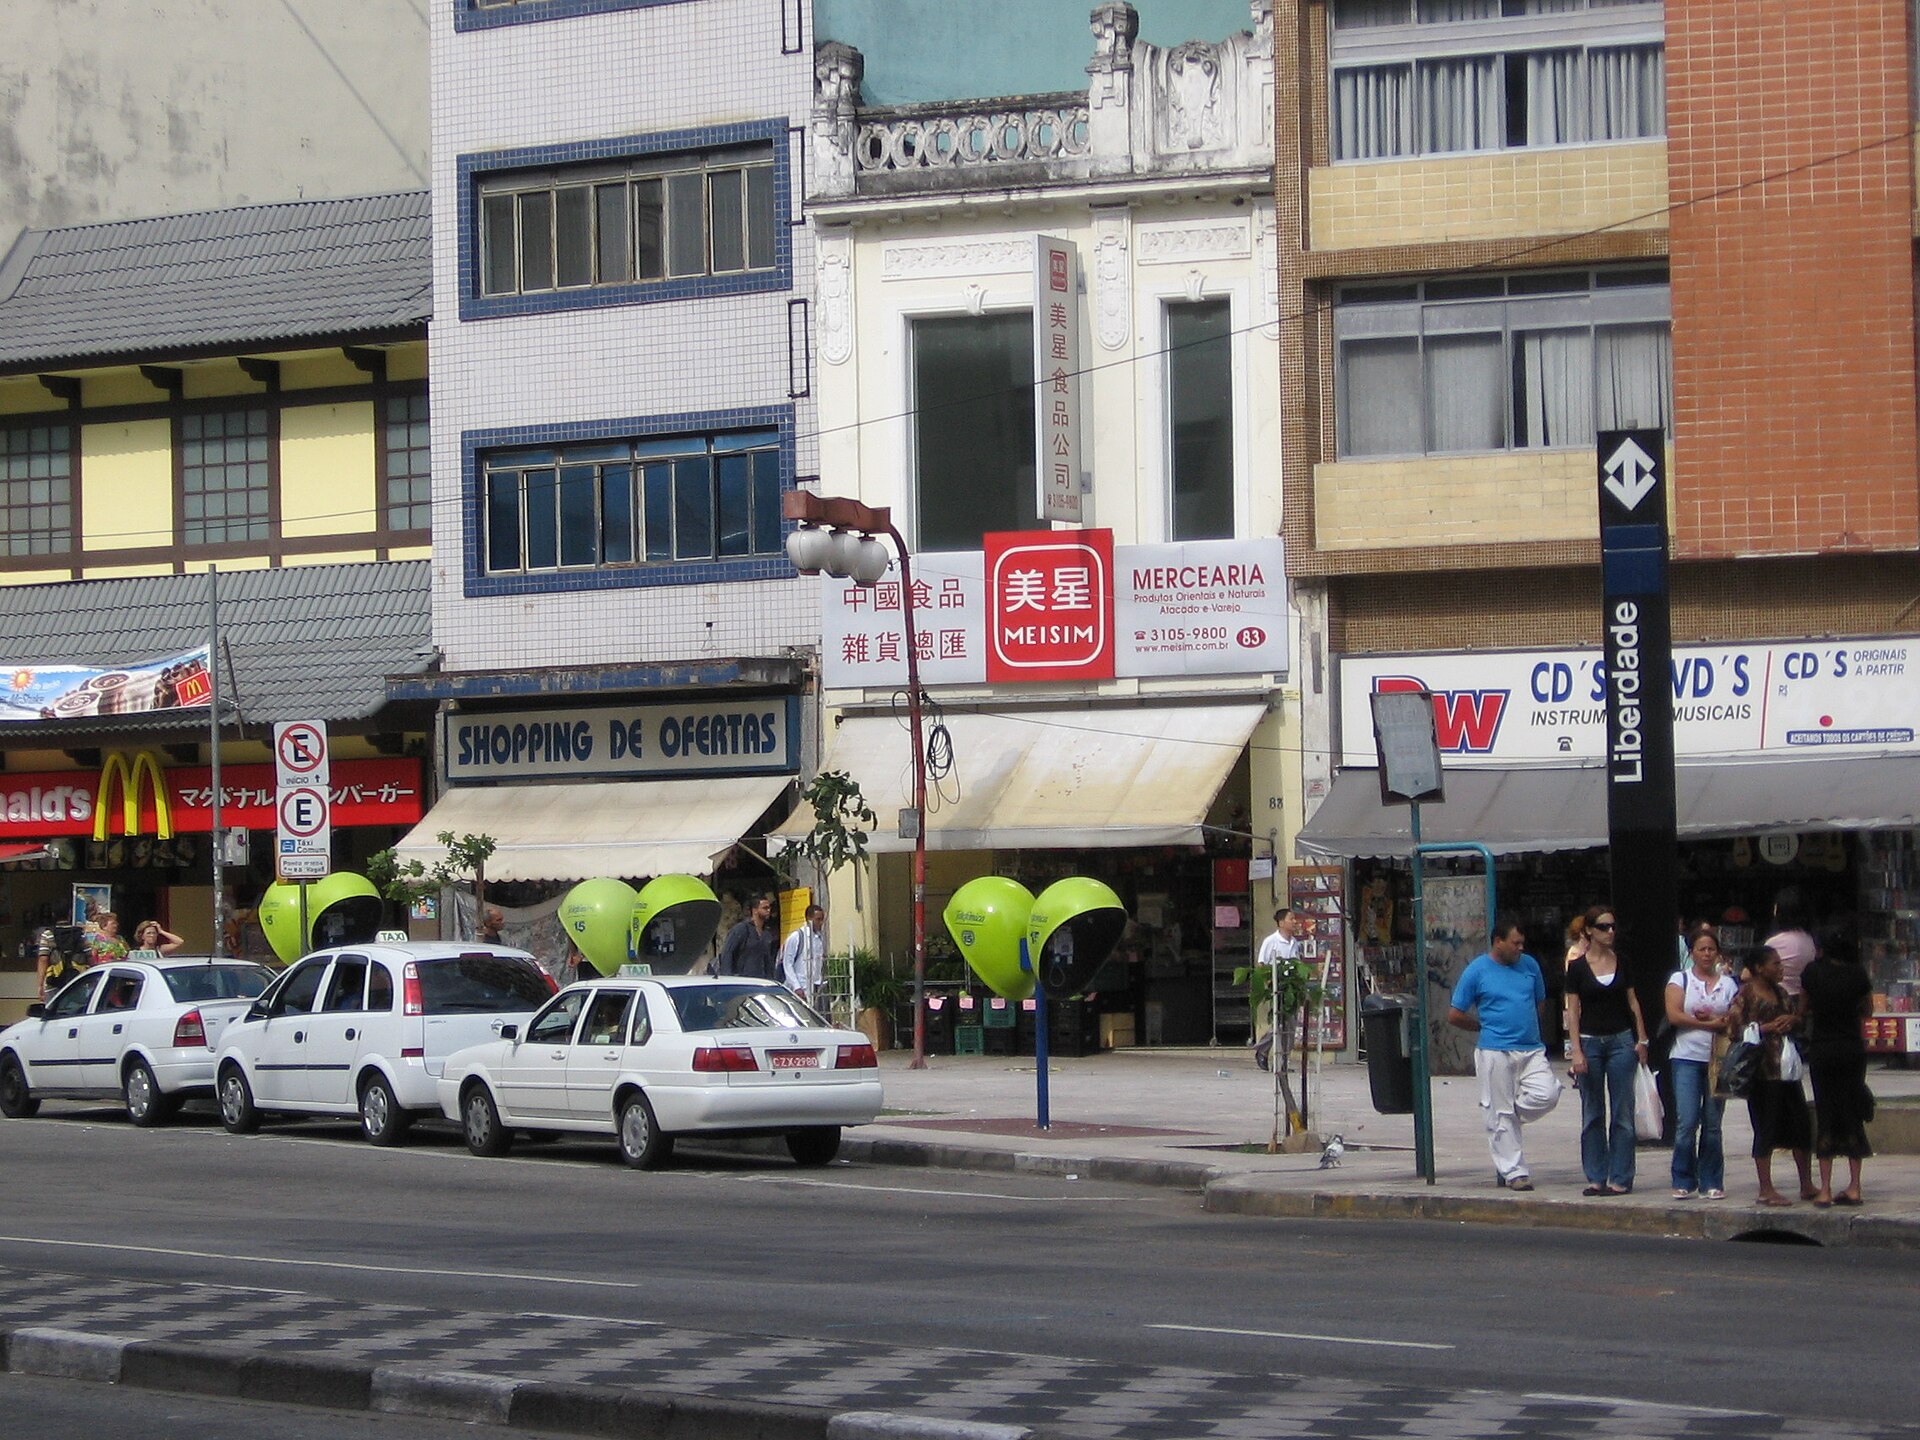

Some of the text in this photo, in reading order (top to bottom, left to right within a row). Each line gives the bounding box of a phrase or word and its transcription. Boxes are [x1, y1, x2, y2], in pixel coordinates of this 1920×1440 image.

[1050, 302, 1070, 490] 美星食品公司
[1005, 567, 1092, 613] 美星
[1133, 564, 1265, 590] MERCEARIA
[843, 578, 965, 613] 中國食品
[1134, 590, 1266, 603] Produtos Orientais e Naturais
[1160, 604, 1200, 614] Atacado
[1212, 603, 1241, 613] Varejo
[842, 629, 968, 664] 雜貨總匯
[1004, 625, 1093, 645] MEISIM
[1135, 641, 1229, 652] www.meisim.com.br
[1150, 627, 1260, 645] 3105-9800 83
[1853, 649, 1907, 662] ORIGINAIS
[1671, 654, 1750, 699] VD'S
[1855, 664, 1904, 676] A PARTIR
[1610, 602, 1643, 782] Liberdade
[1672, 704, 1751, 721] MUSICAIS
[293, 734, 310, 762] E
[458, 713, 776, 766] SHOPPING DE OFERTAS
[296, 799, 312, 826] E
[381, 932, 405, 941] TAXI
